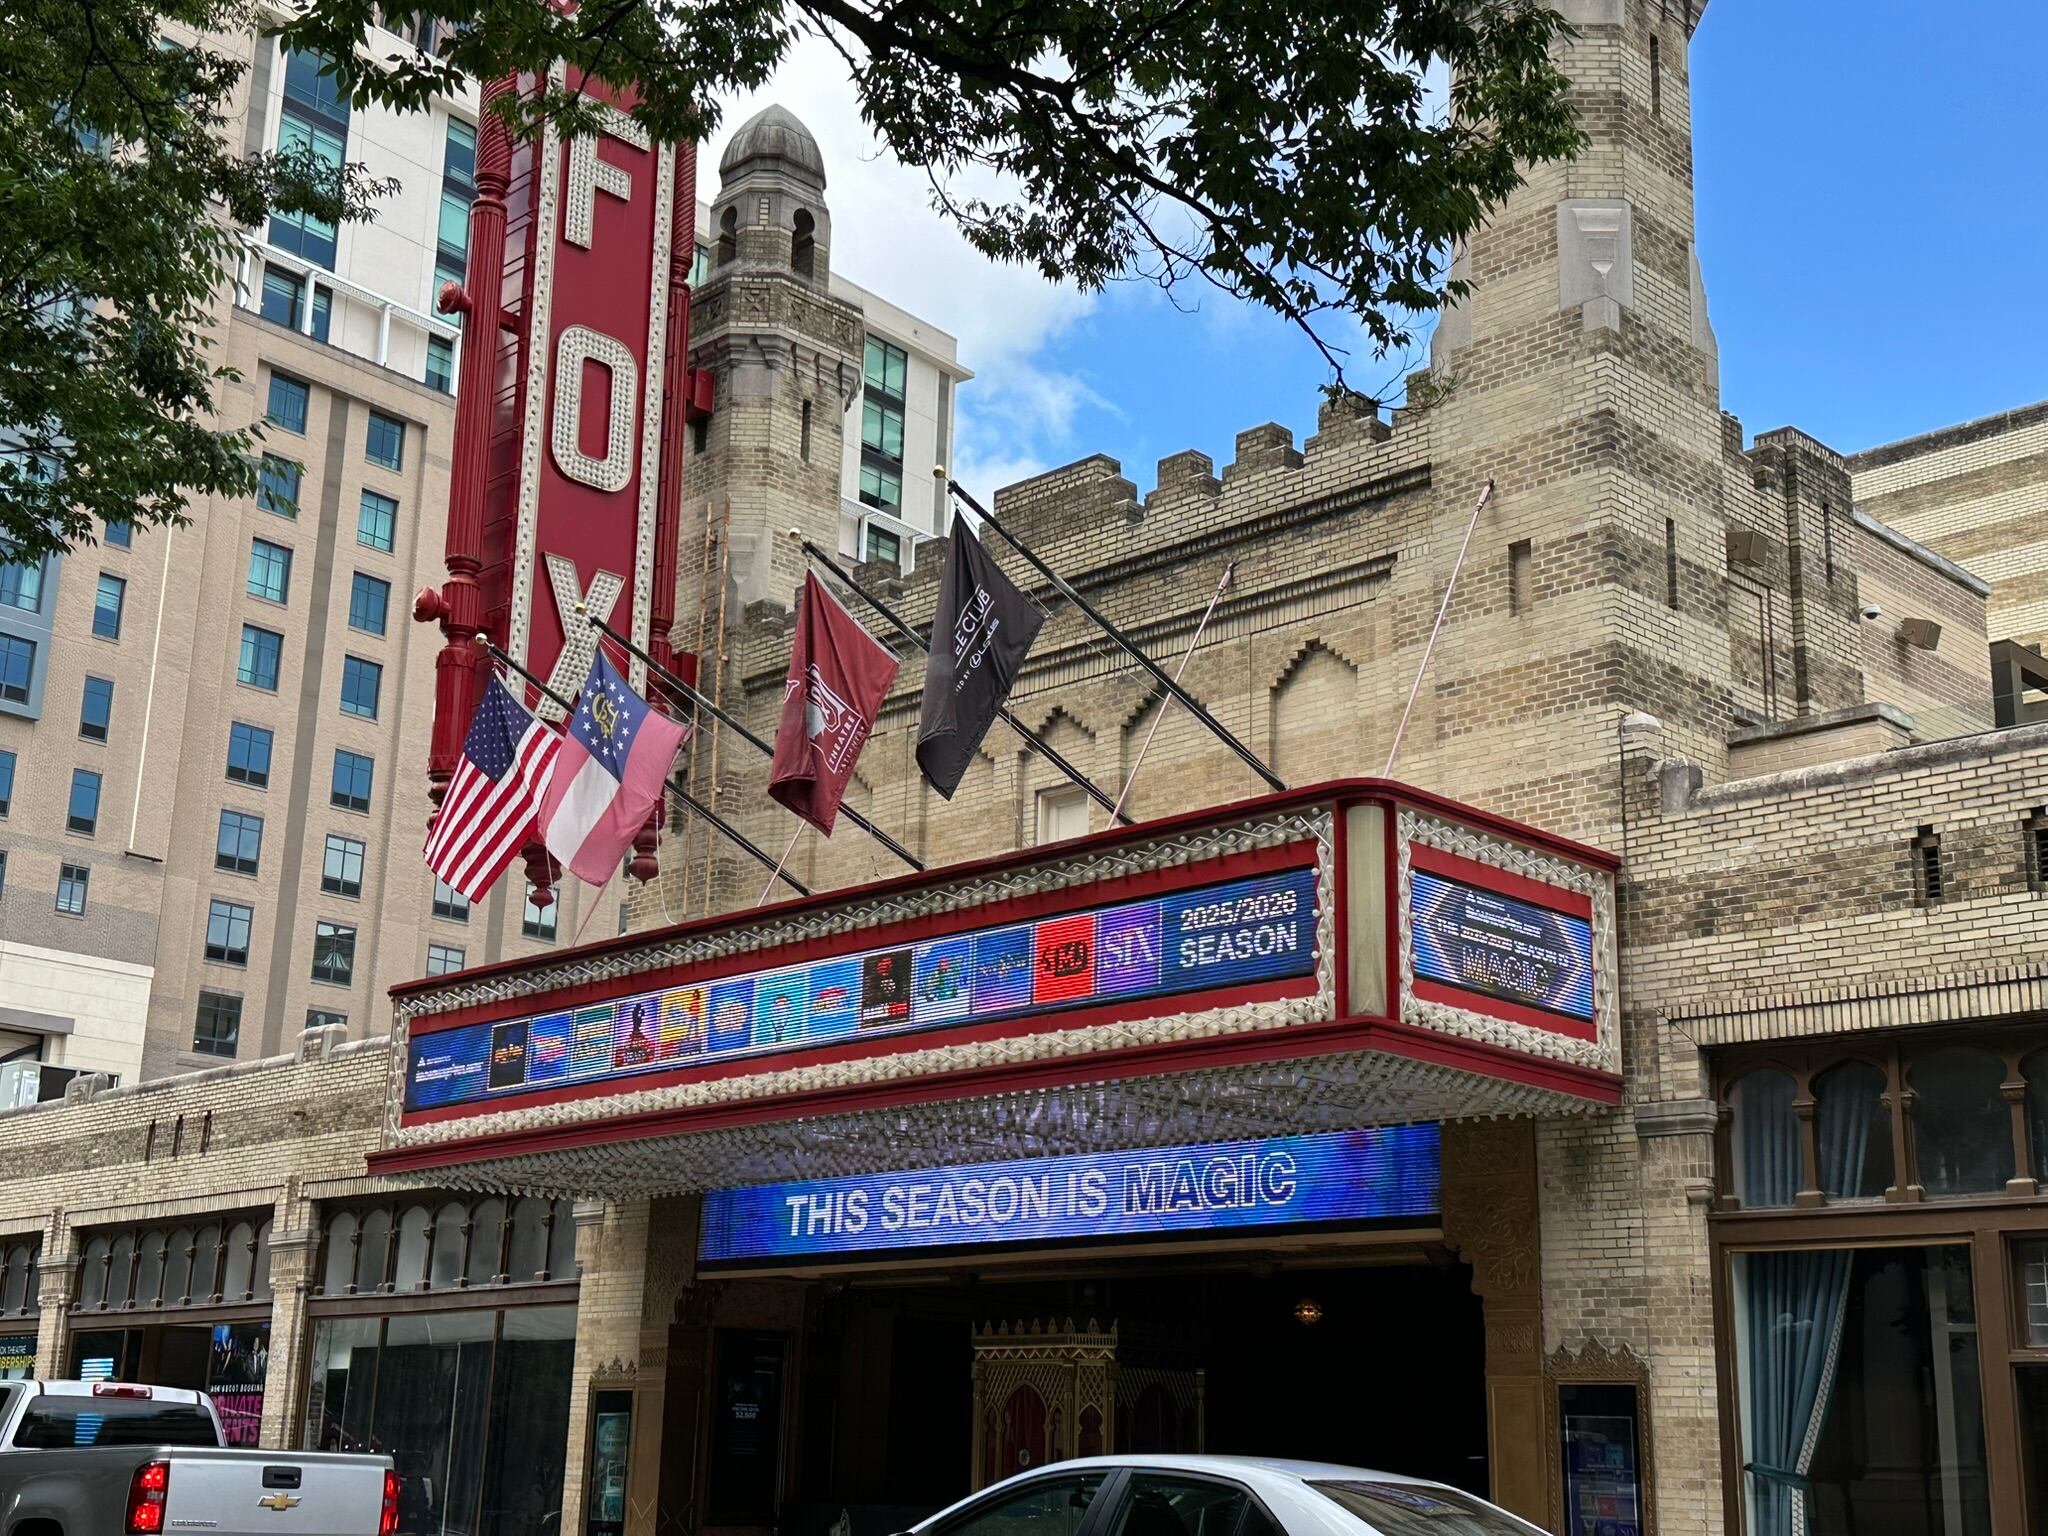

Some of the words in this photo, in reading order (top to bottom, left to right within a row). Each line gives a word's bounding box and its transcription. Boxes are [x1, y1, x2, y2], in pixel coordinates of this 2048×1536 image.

[535, 88, 651, 723] FOX
[962, 588, 991, 634] CLUB
[828, 714, 856, 766] THEATRE
[1180, 890, 1298, 931] 2025/2026
[1101, 924, 1155, 969] SIX
[1180, 921, 1297, 968] SEASON
[1462, 943, 1548, 998] MAGIC
[786, 1189, 869, 1236] THIS
[880, 1173, 1050, 1231] SEASON
[1067, 1169, 1107, 1217] IS
[1123, 1151, 1296, 1215] MAGIC
[210, 1384, 220, 1392] ASK
[221, 1384, 239, 1392] ABOUT
[240, 1383, 263, 1392] BOOKING
[211, 1394, 262, 1417] PRIVATE
